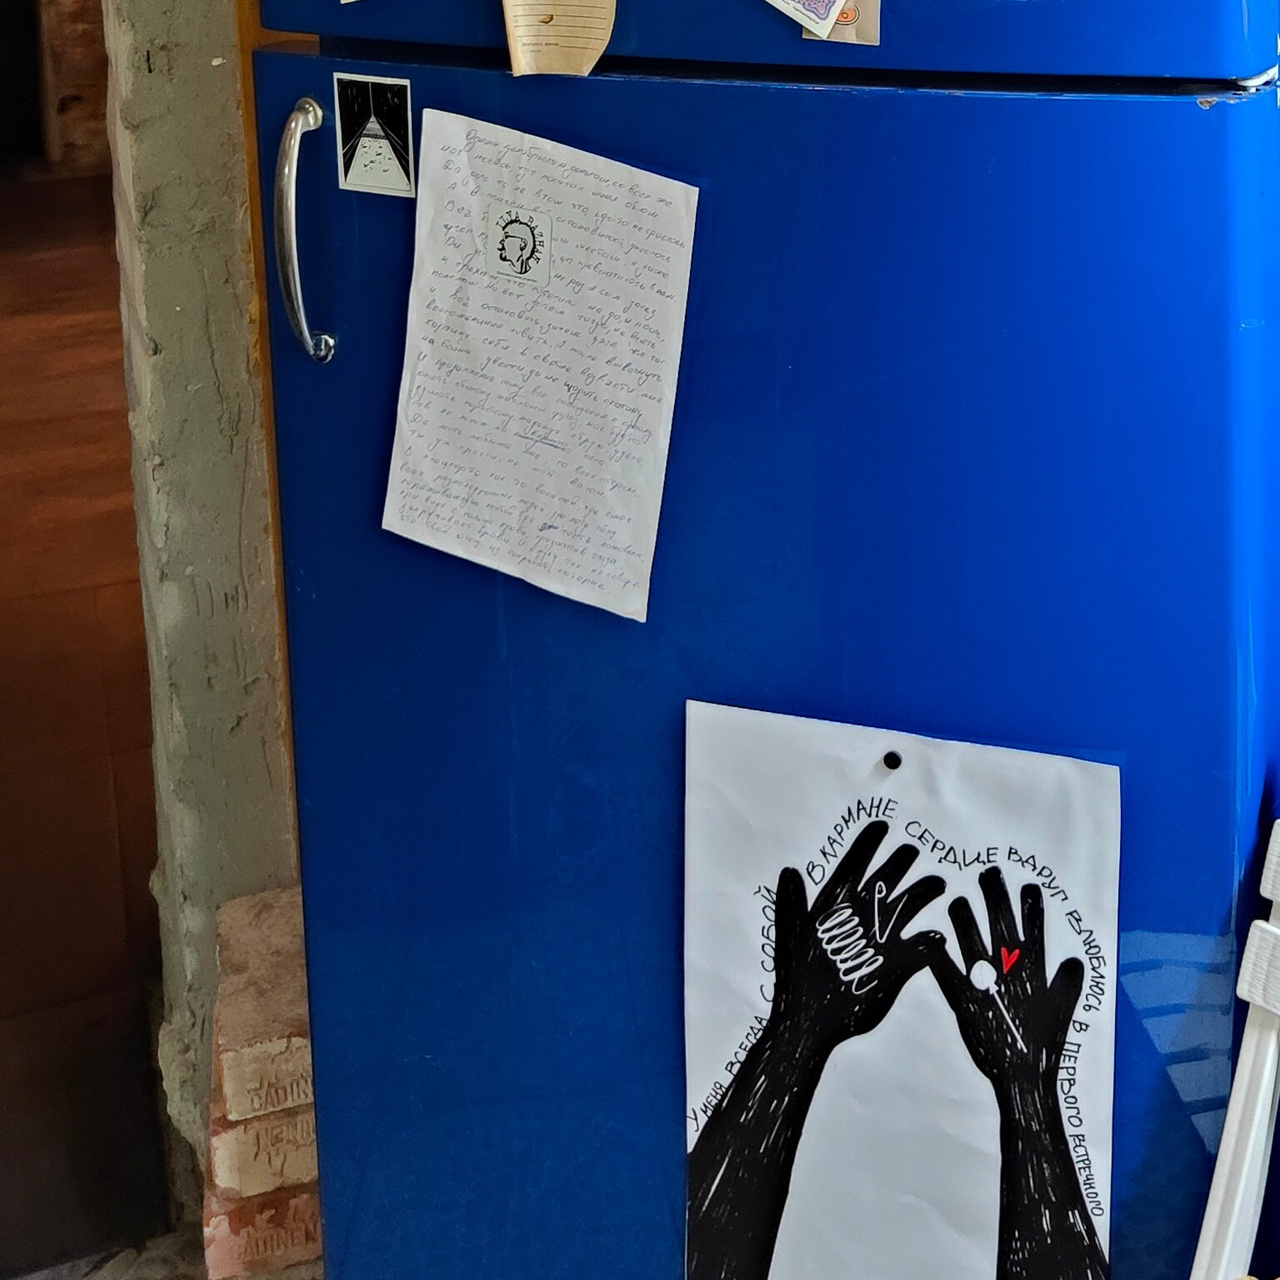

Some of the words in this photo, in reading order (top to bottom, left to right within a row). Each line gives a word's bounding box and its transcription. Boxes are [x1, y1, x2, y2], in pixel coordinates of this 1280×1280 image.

[527, 215, 545, 264] BAZHAN
[821, 796, 900, 867] КАРМАНЕ
[904, 820, 1000, 871] СЕРДЦЕ
[1006, 845, 1070, 905] ВДРУГ
[753, 885, 781, 978] СОБОЙ
[1064, 908, 1109, 1013] ВЛЮБЛЮСЬ
[758, 983, 777, 1005] С
[724, 1013, 770, 1080] ВСЕГДА
[1072, 1021, 1091, 1034] В
[700, 1080, 729, 1118] МЕНЯ
[1059, 1040, 1084, 1131] ПЕРВОГО
[690, 1107, 703, 1134] У
[1068, 1132, 1106, 1218] ВСТРЕЧНОГО
